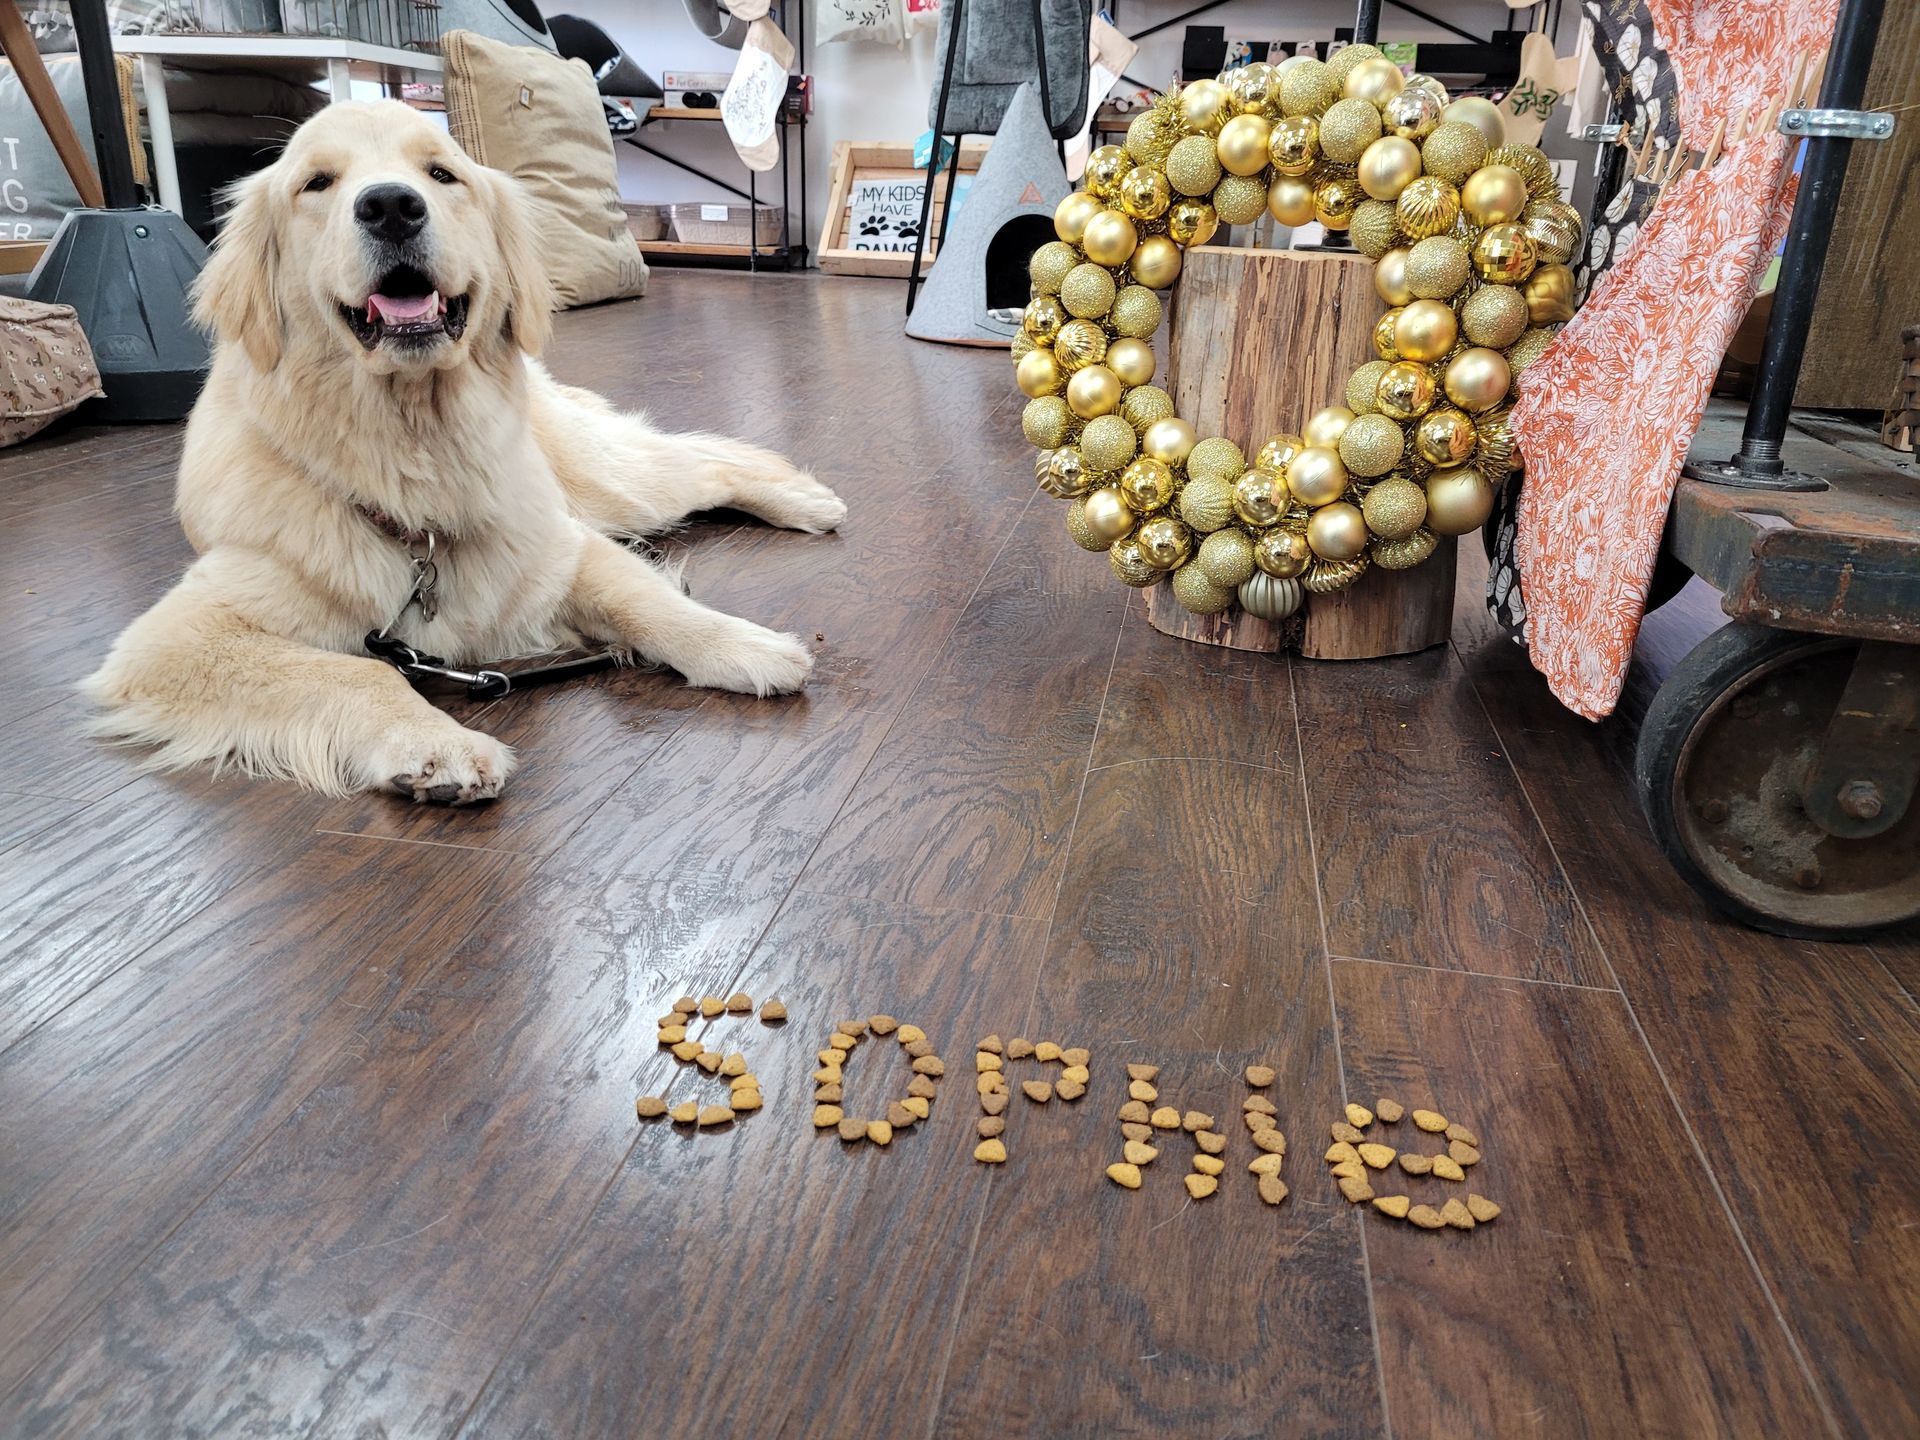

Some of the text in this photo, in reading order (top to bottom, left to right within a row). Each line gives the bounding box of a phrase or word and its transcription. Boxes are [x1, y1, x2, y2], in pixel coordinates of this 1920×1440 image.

[863, 185, 926, 202] MY KIDS
[872, 203, 913, 216] HAVE
